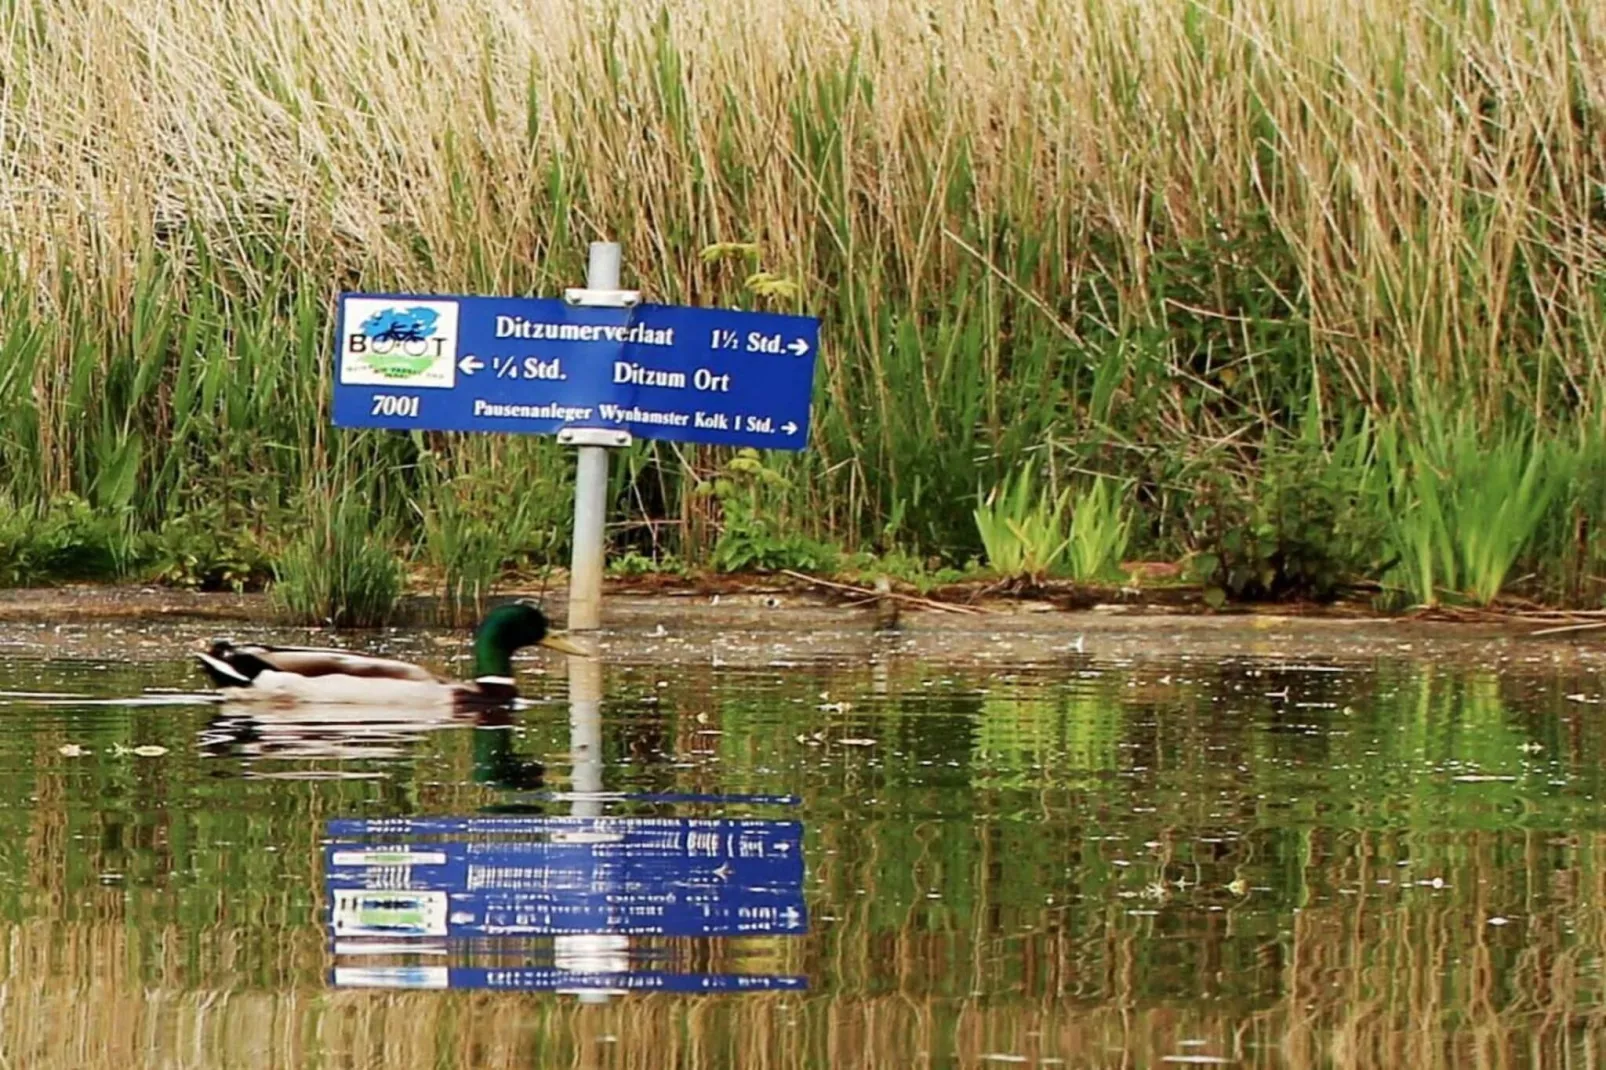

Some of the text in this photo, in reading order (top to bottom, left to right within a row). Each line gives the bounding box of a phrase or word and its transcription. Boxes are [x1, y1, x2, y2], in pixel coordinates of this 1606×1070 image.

[495, 315, 674, 346] Ditzumerverlaat
[746, 331, 787, 354] Std.
[523, 357, 567, 380] Std.
[613, 361, 686, 389] Ditzum
[693, 368, 731, 392] Ort
[371, 394, 420, 417] 7001
[474, 399, 593, 422] Pausenanleger
[599, 403, 690, 427] Wynhamster
[694, 410, 728, 431] Kolk
[746, 416, 776, 434] Std.
